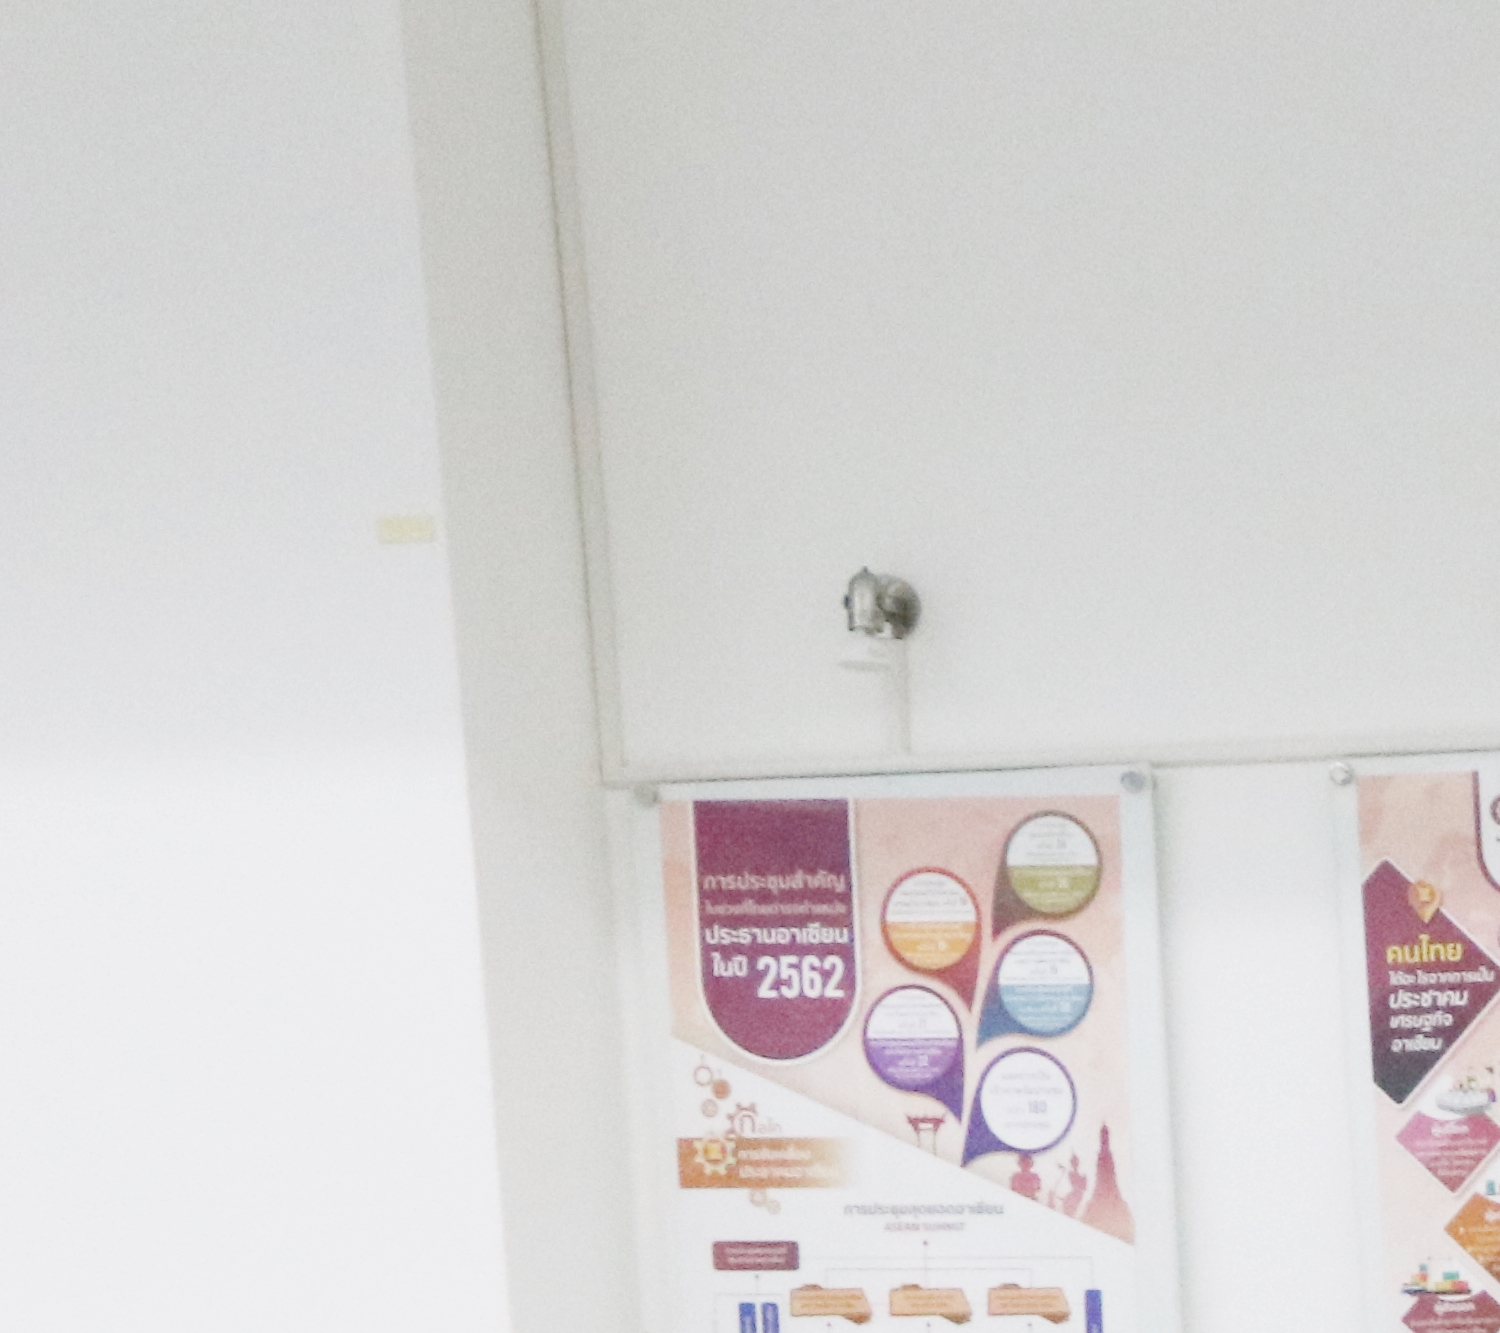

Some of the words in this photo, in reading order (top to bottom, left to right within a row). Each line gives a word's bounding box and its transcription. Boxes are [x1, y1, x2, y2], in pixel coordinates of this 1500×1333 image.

[705, 922, 848, 944] ประธานอาเซียน
[1386, 933, 1463, 964] คนไทย
[711, 952, 748, 978] ในปี
[757, 955, 845, 998] 2562
